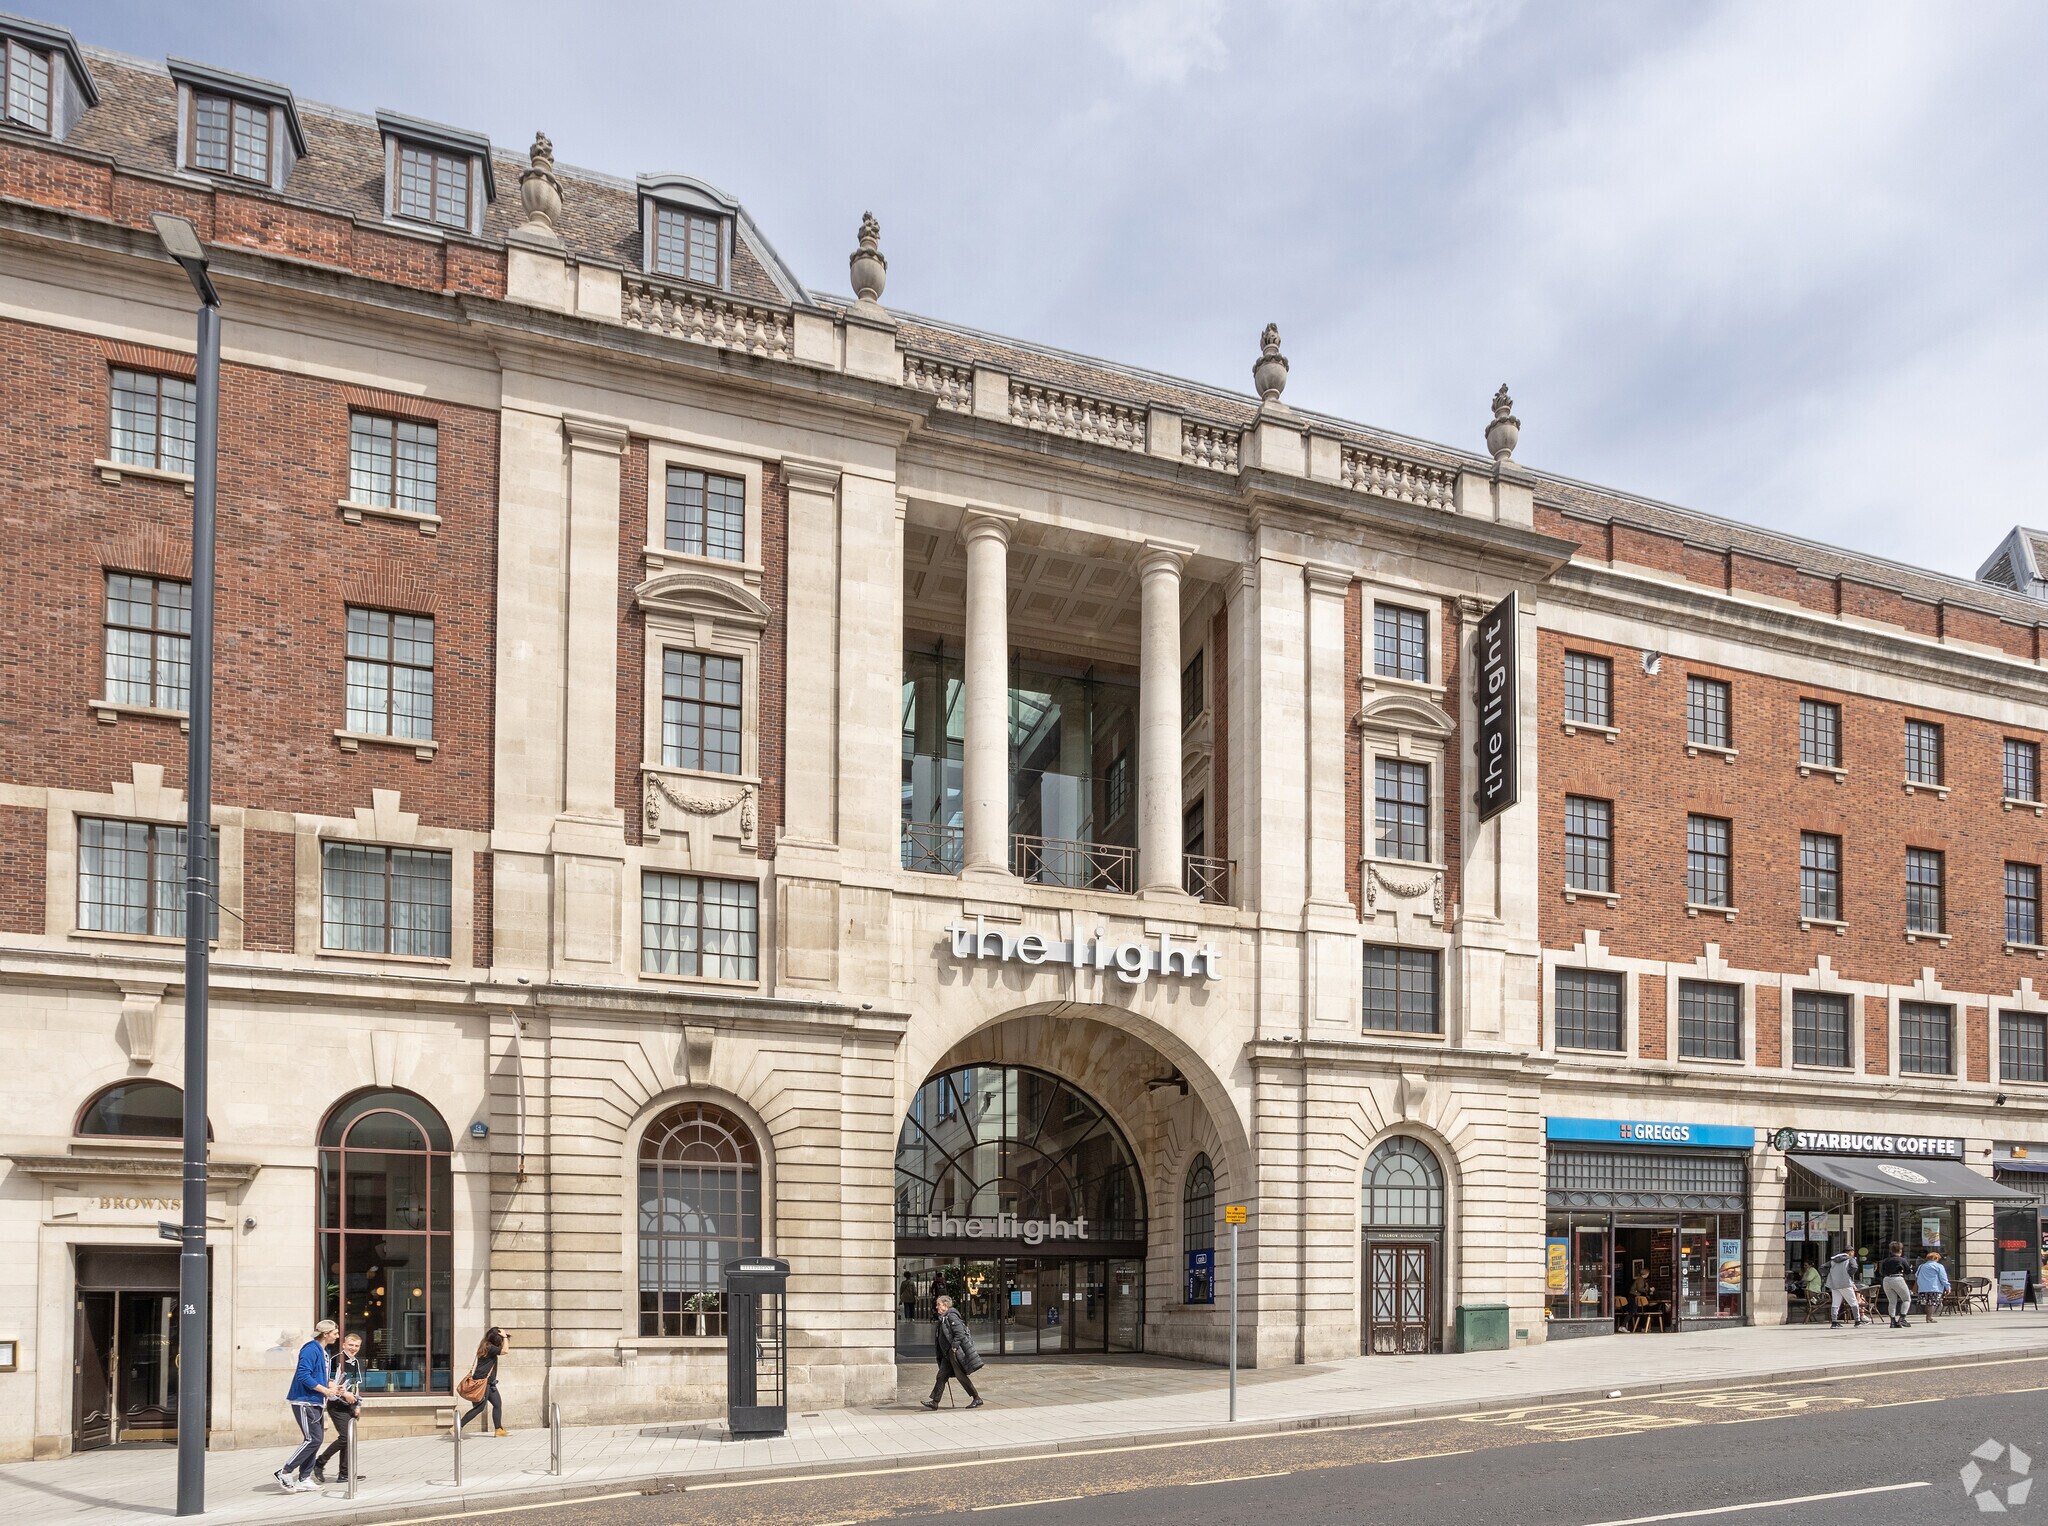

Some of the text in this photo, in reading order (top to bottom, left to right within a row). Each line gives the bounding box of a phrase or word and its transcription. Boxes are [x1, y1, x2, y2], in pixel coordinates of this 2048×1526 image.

[1484, 618, 1506, 799] the light
[944, 914, 1222, 984] the light
[1634, 1123, 1690, 1141] GREGGS
[1796, 1132, 1955, 1153] STARBUCKS COFFEE
[99, 1196, 181, 1211] BROWNS
[924, 1211, 1089, 1245] the light
[1722, 1245, 1738, 1254] TASTY
[1648, 1391, 1866, 1412] BUS
[1458, 1407, 1703, 1433] STOP
